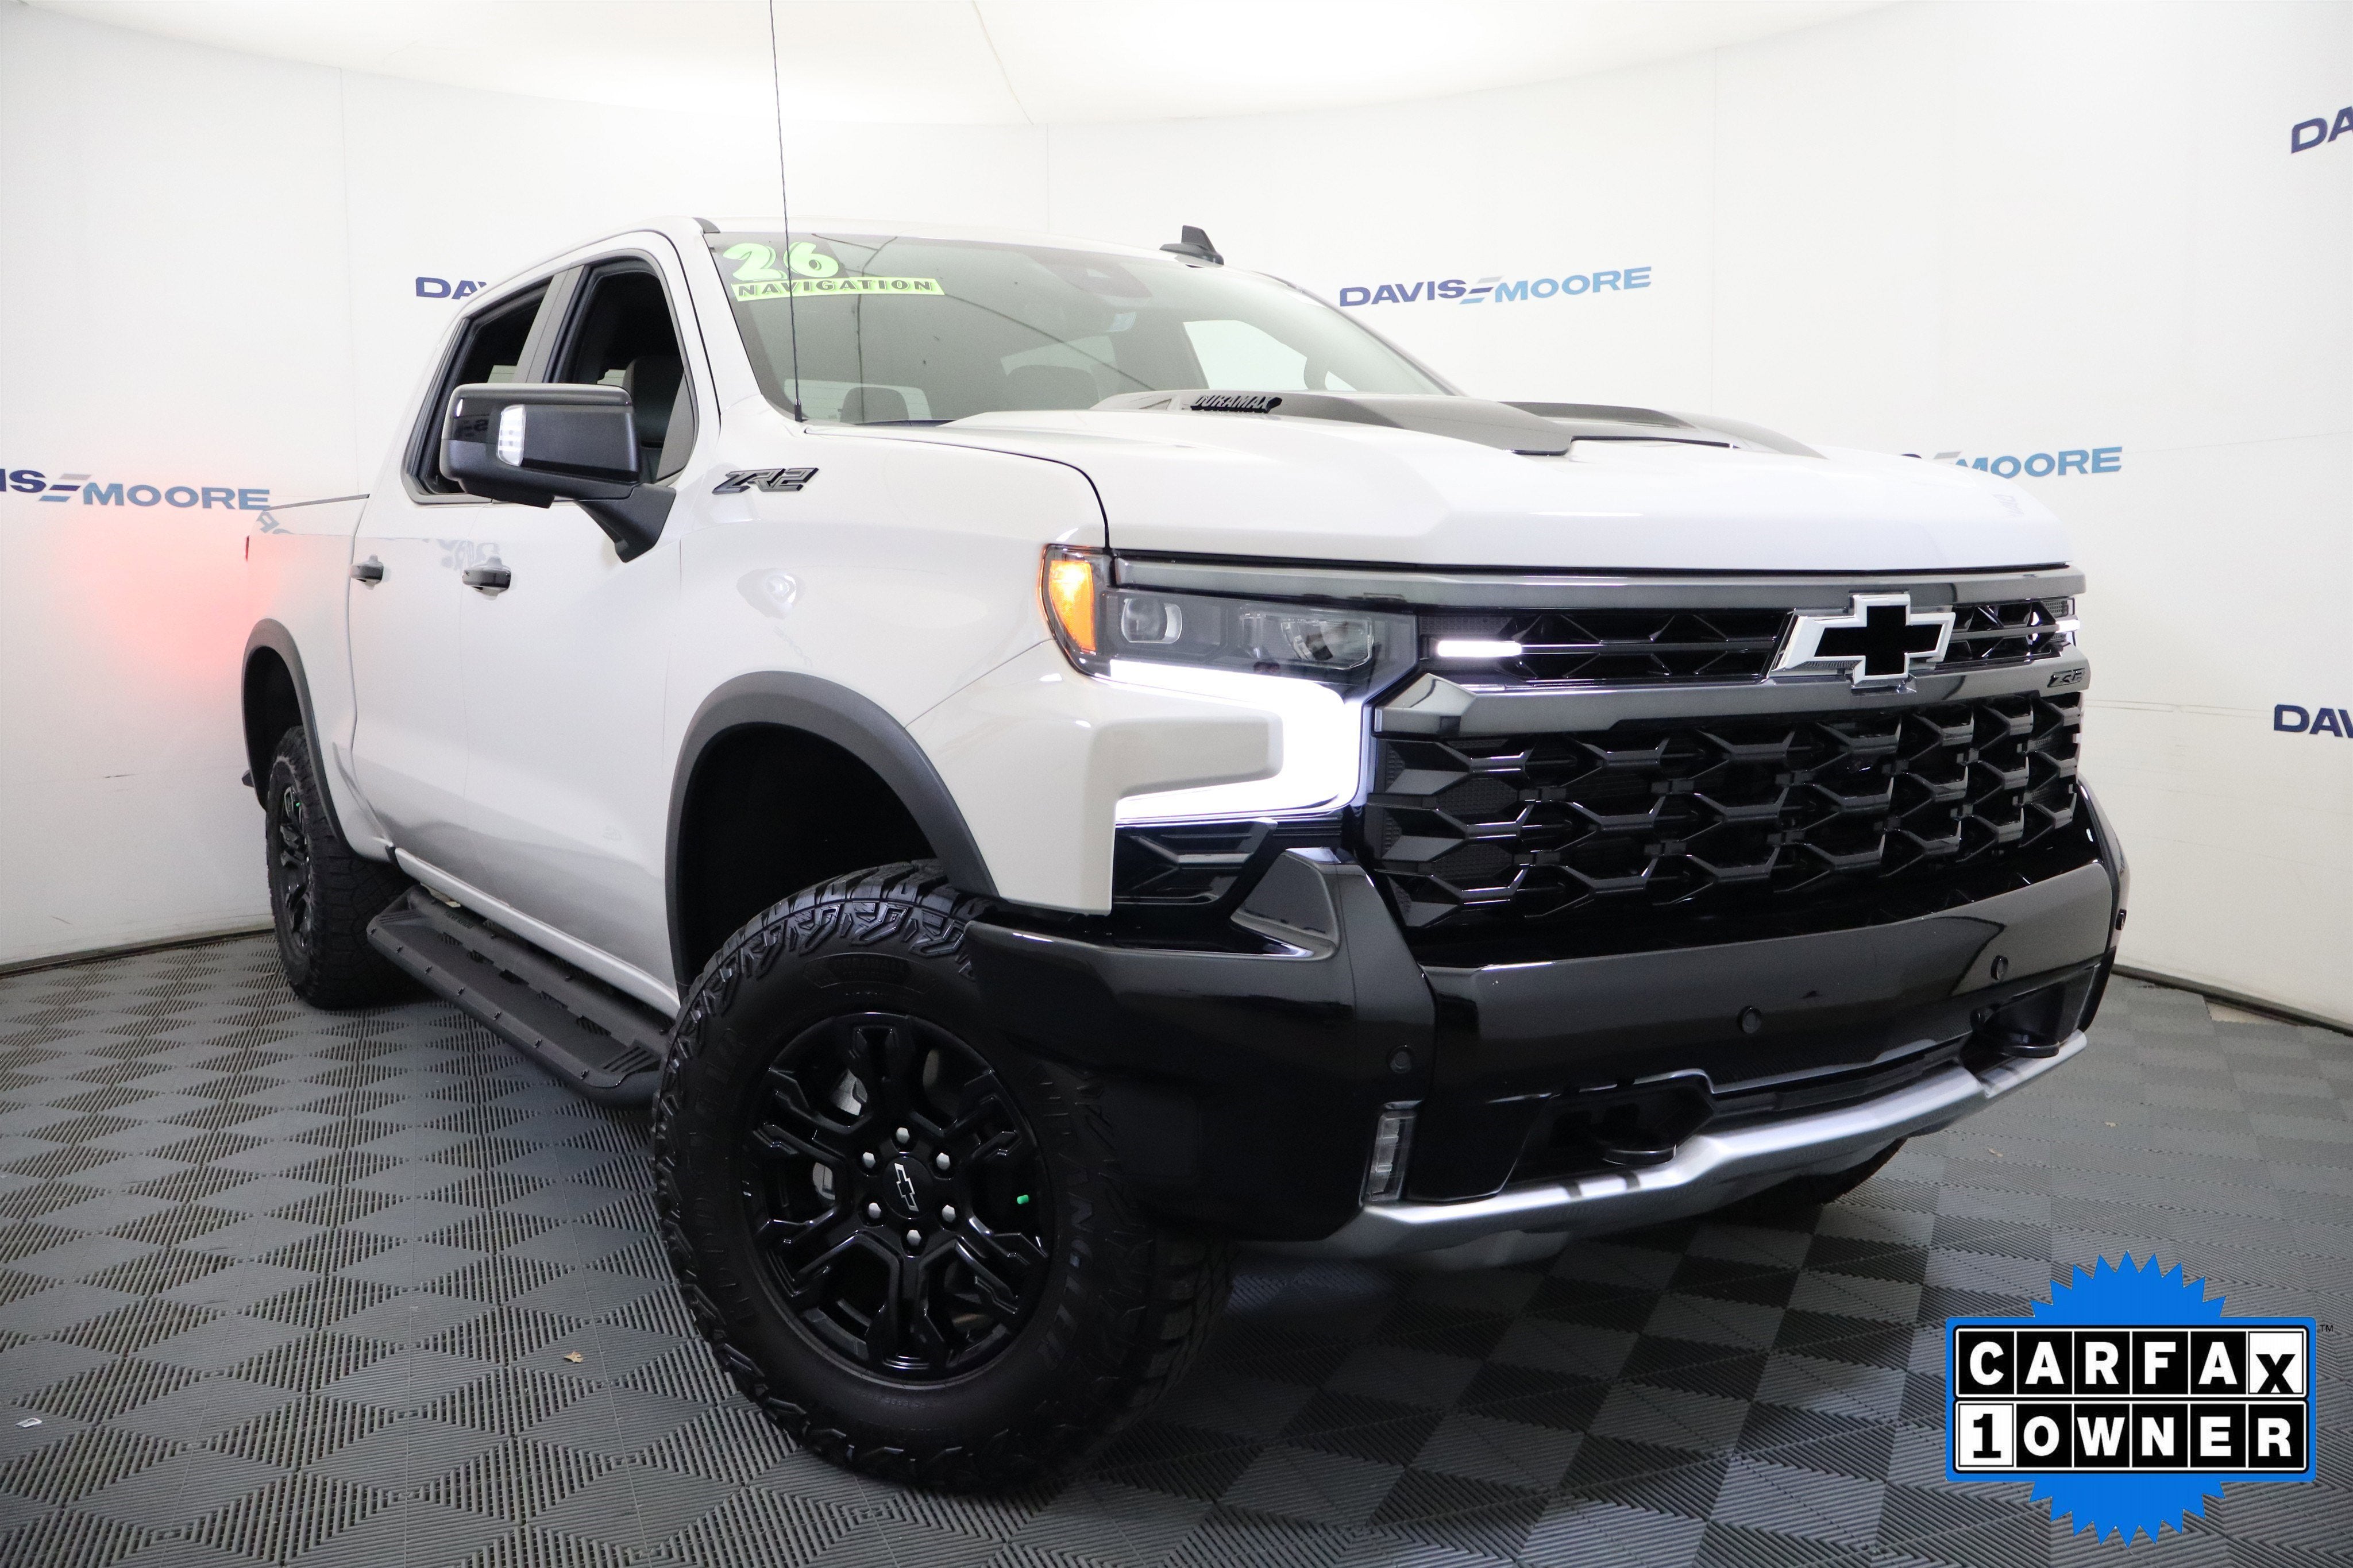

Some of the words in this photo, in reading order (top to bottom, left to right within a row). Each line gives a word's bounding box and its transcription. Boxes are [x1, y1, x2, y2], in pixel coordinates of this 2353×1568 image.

[723, 241, 839, 281] 26
[415, 276, 487, 300] DA
[738, 279, 935, 297] NAVIGATION
[1340, 279, 1467, 307] DAVIS
[1495, 266, 1652, 303] MOORE
[1190, 395, 1272, 413] DURAMAX
[712, 468, 819, 495] ZR2
[83, 482, 271, 511] MOORE
